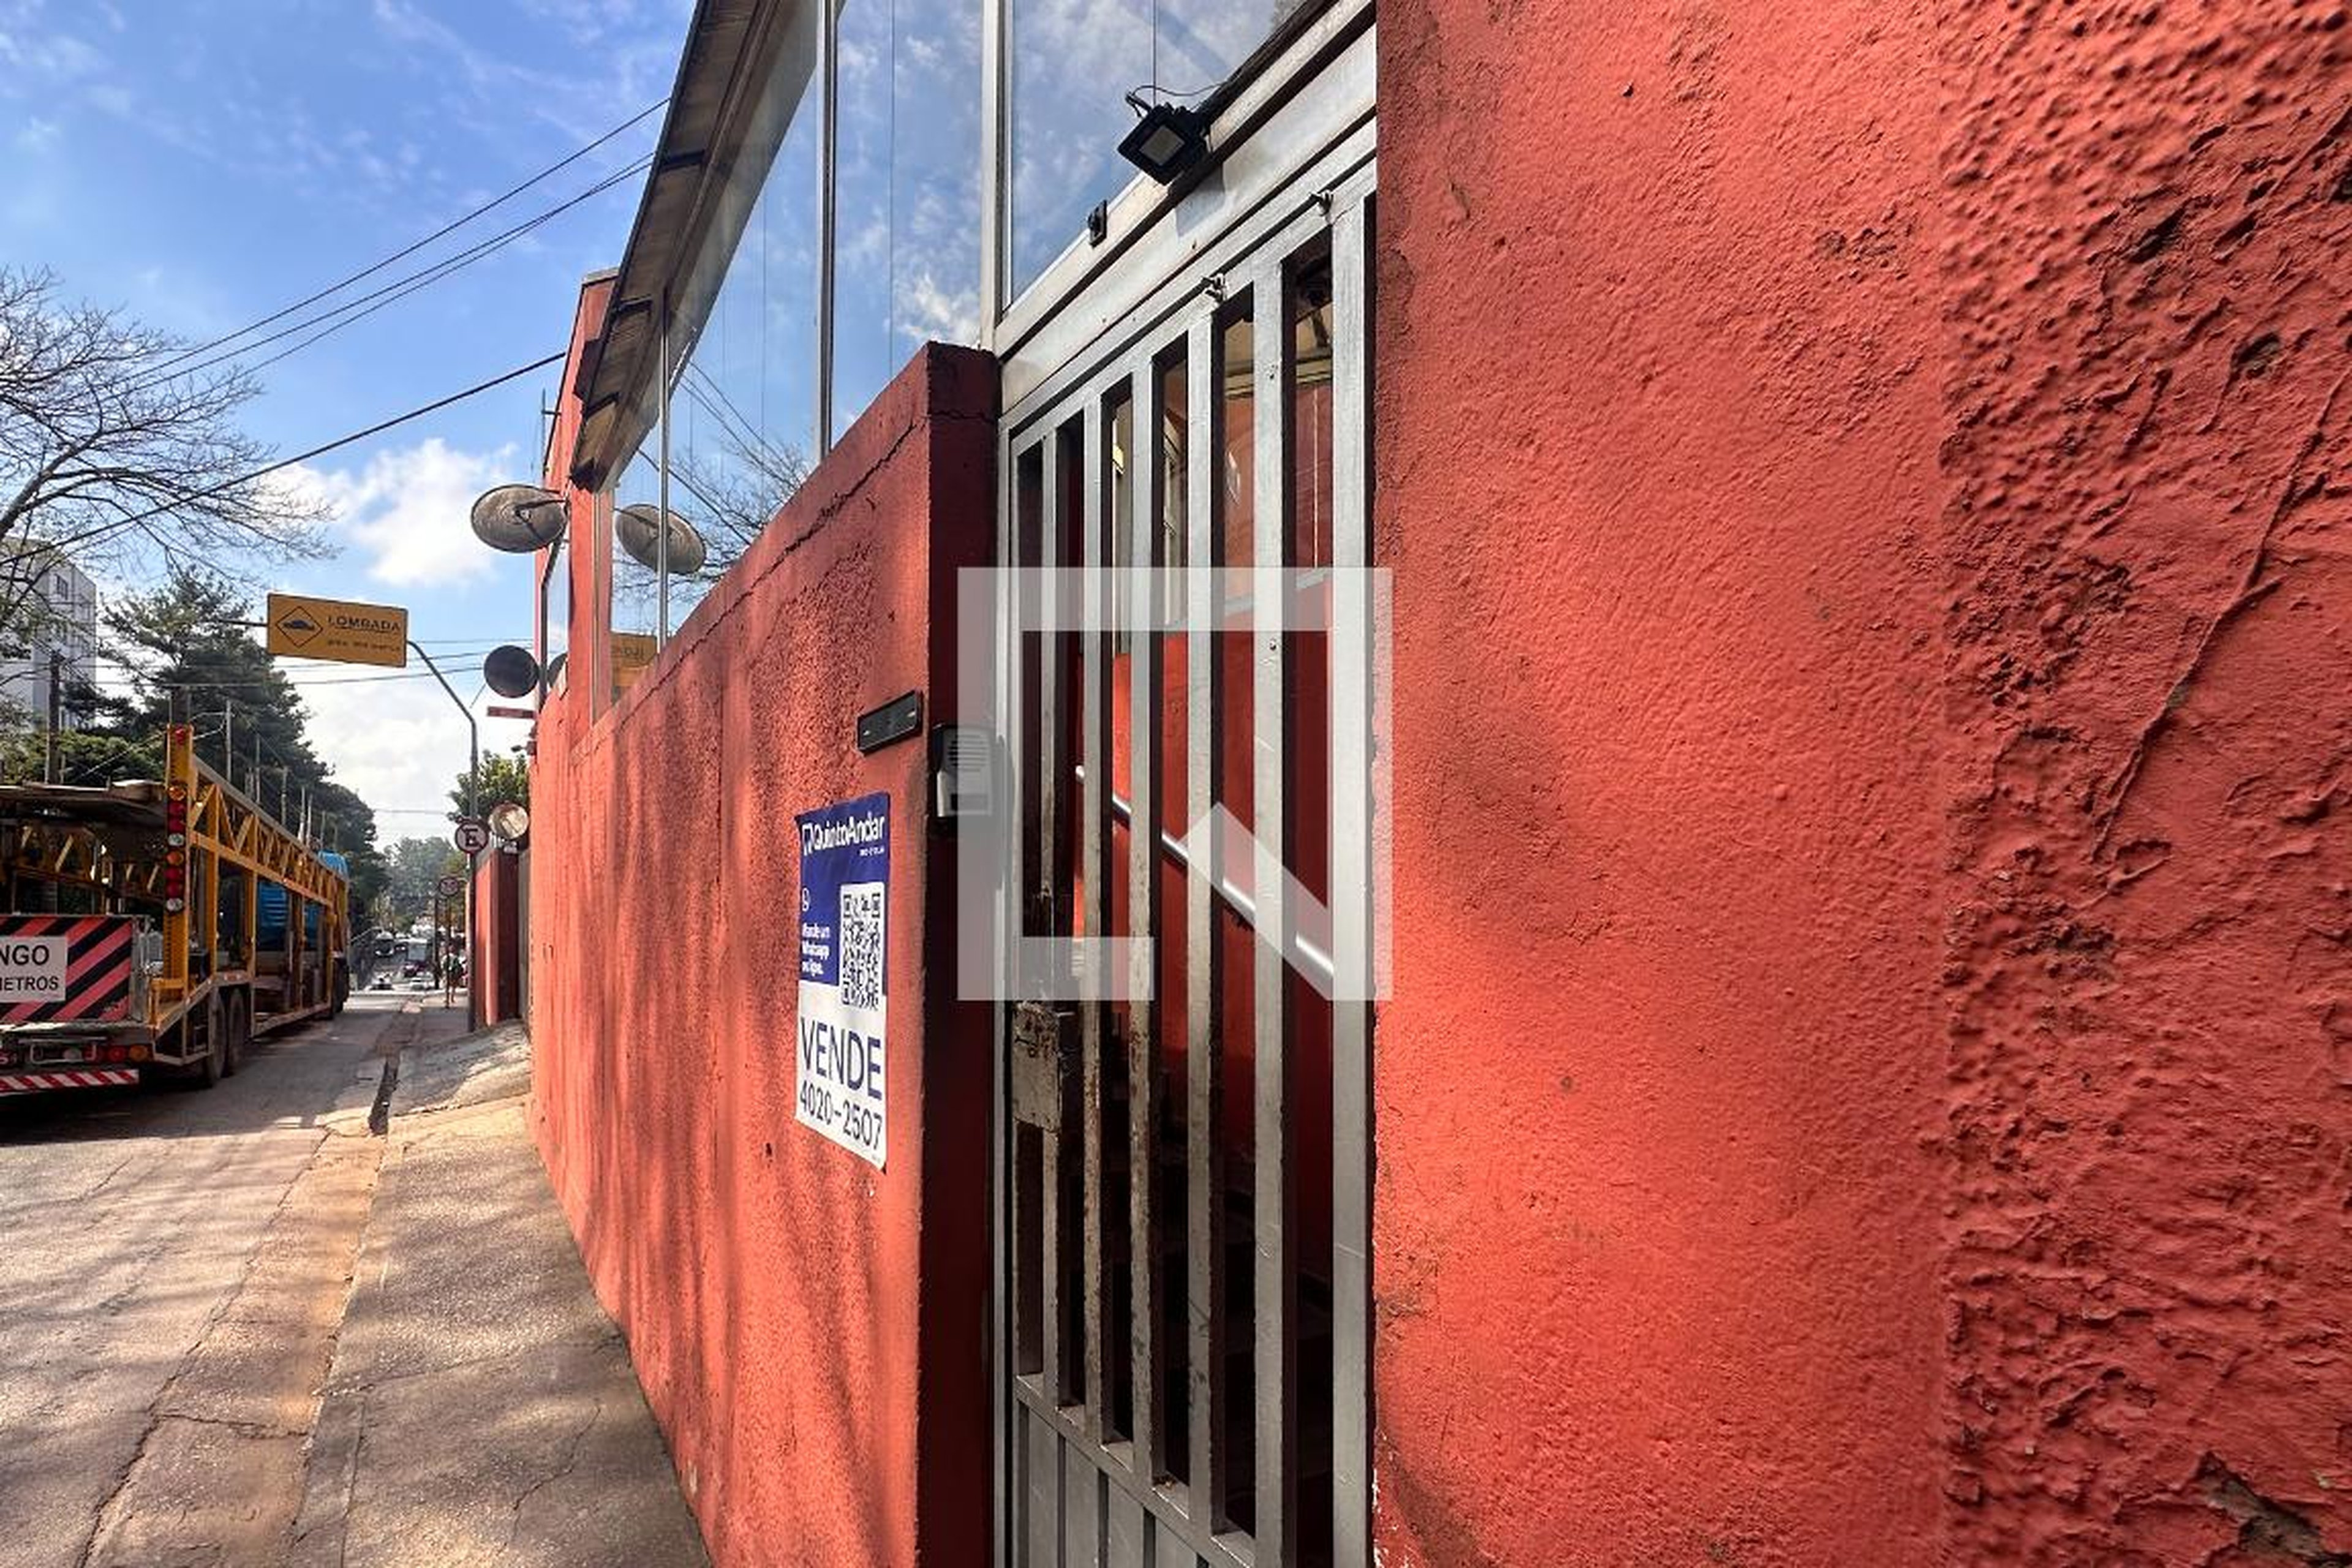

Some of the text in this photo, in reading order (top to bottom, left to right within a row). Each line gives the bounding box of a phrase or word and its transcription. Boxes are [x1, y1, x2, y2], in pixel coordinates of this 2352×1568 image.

[328, 616, 401, 631] LOMBADA
[814, 812, 885, 850] QuintoAndar
[0, 976, 59, 990] ETROS
[801, 1016, 882, 1101] VENDE
[800, 1079, 882, 1150] 4020-2507
